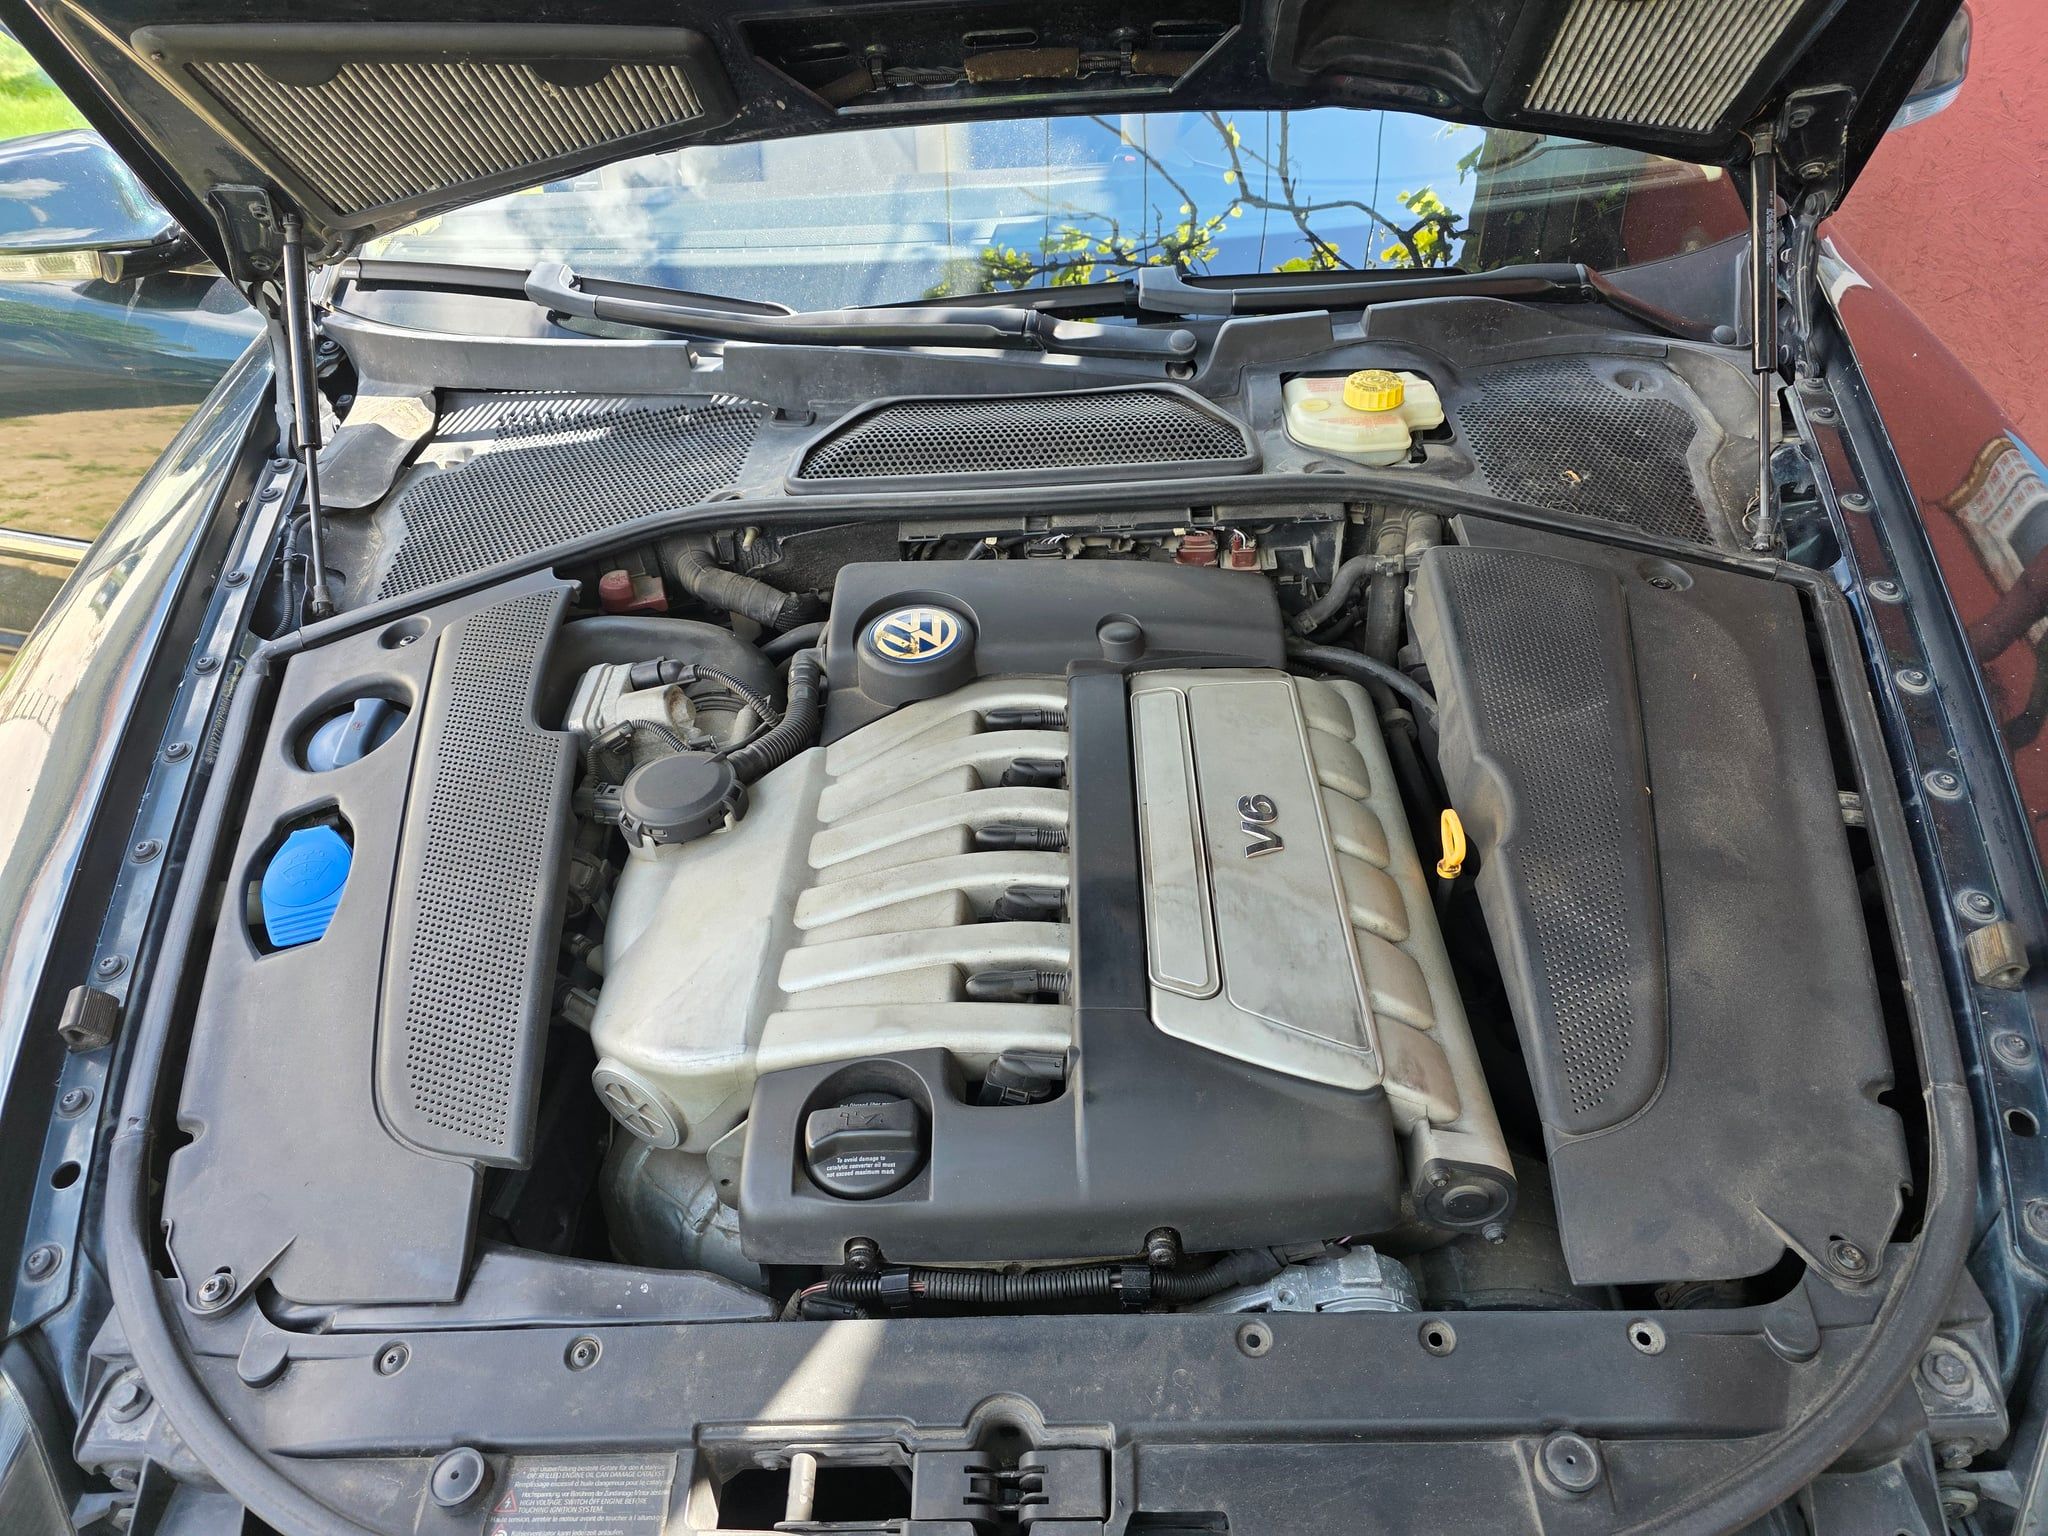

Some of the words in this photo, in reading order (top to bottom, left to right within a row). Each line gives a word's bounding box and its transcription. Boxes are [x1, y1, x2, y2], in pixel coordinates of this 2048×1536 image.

[1237, 794, 1284, 858] V6
[835, 1169, 854, 1177] exceed
[562, 1471, 585, 1479] ENGINE
[520, 1498, 534, 1506] HIGH
[600, 1497, 624, 1505] ENGINE
[518, 1506, 549, 1514] TOUCHING
